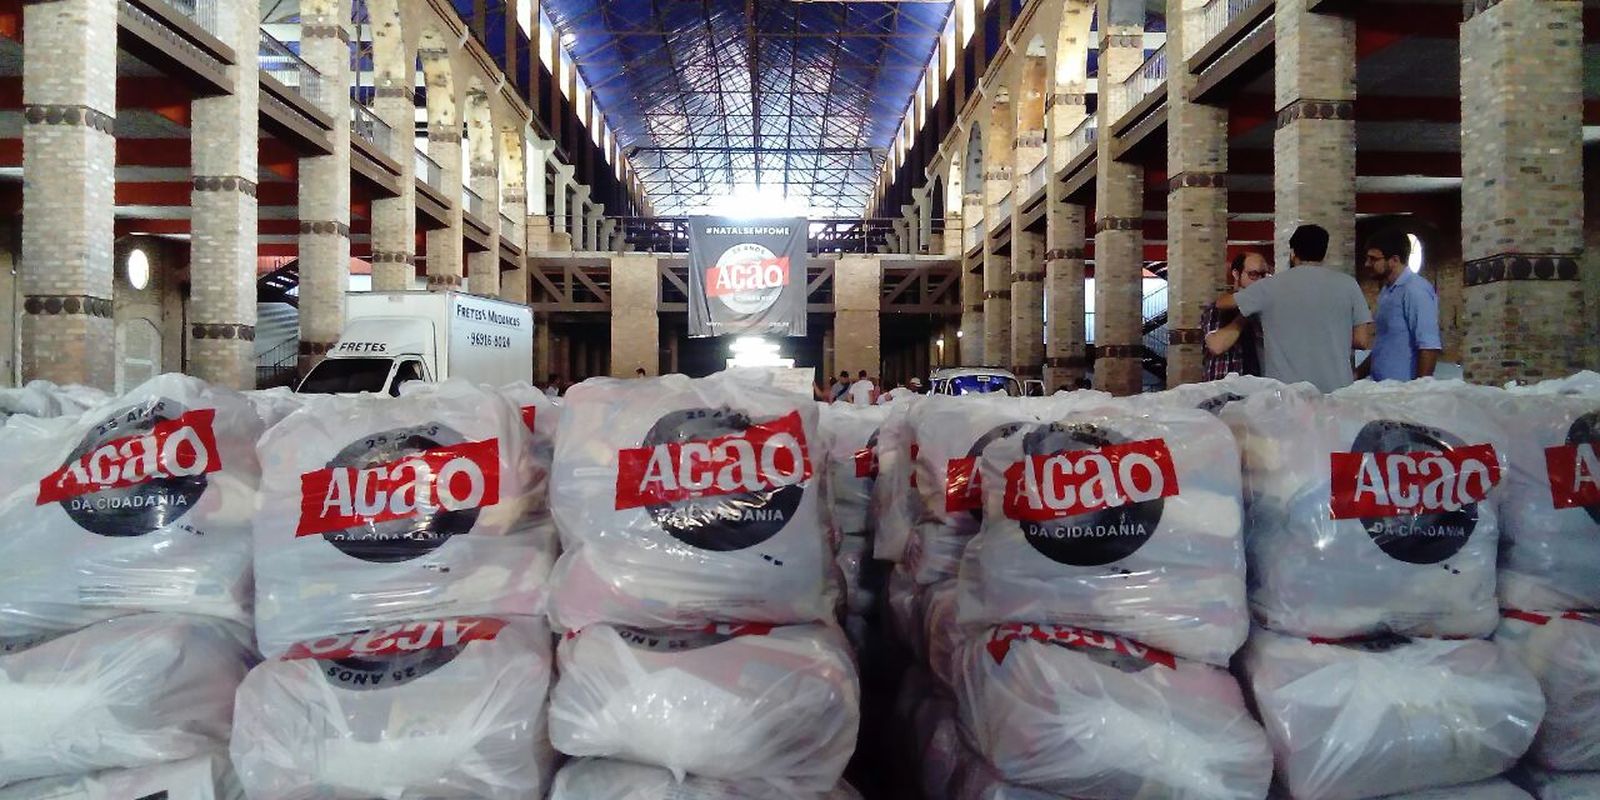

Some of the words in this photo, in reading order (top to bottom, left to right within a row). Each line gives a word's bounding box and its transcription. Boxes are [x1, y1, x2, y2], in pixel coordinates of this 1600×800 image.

[705, 227, 790, 236] #NATALSEMFOME
[715, 259, 784, 292] Ação
[339, 342, 387, 352] FRETES
[57, 426, 209, 491] Ação
[639, 430, 804, 496] Ação
[320, 450, 485, 523] Ação
[1014, 447, 1164, 516] Ação
[1354, 450, 1493, 514] Ação
[72, 499, 92, 511] DA
[97, 494, 188, 510] CIDADANIA
[1029, 524, 1049, 538] DA
[1055, 523, 1147, 538] CIDADANIA
[327, 666, 384, 685] ANOS
[393, 667, 416, 681] 25
